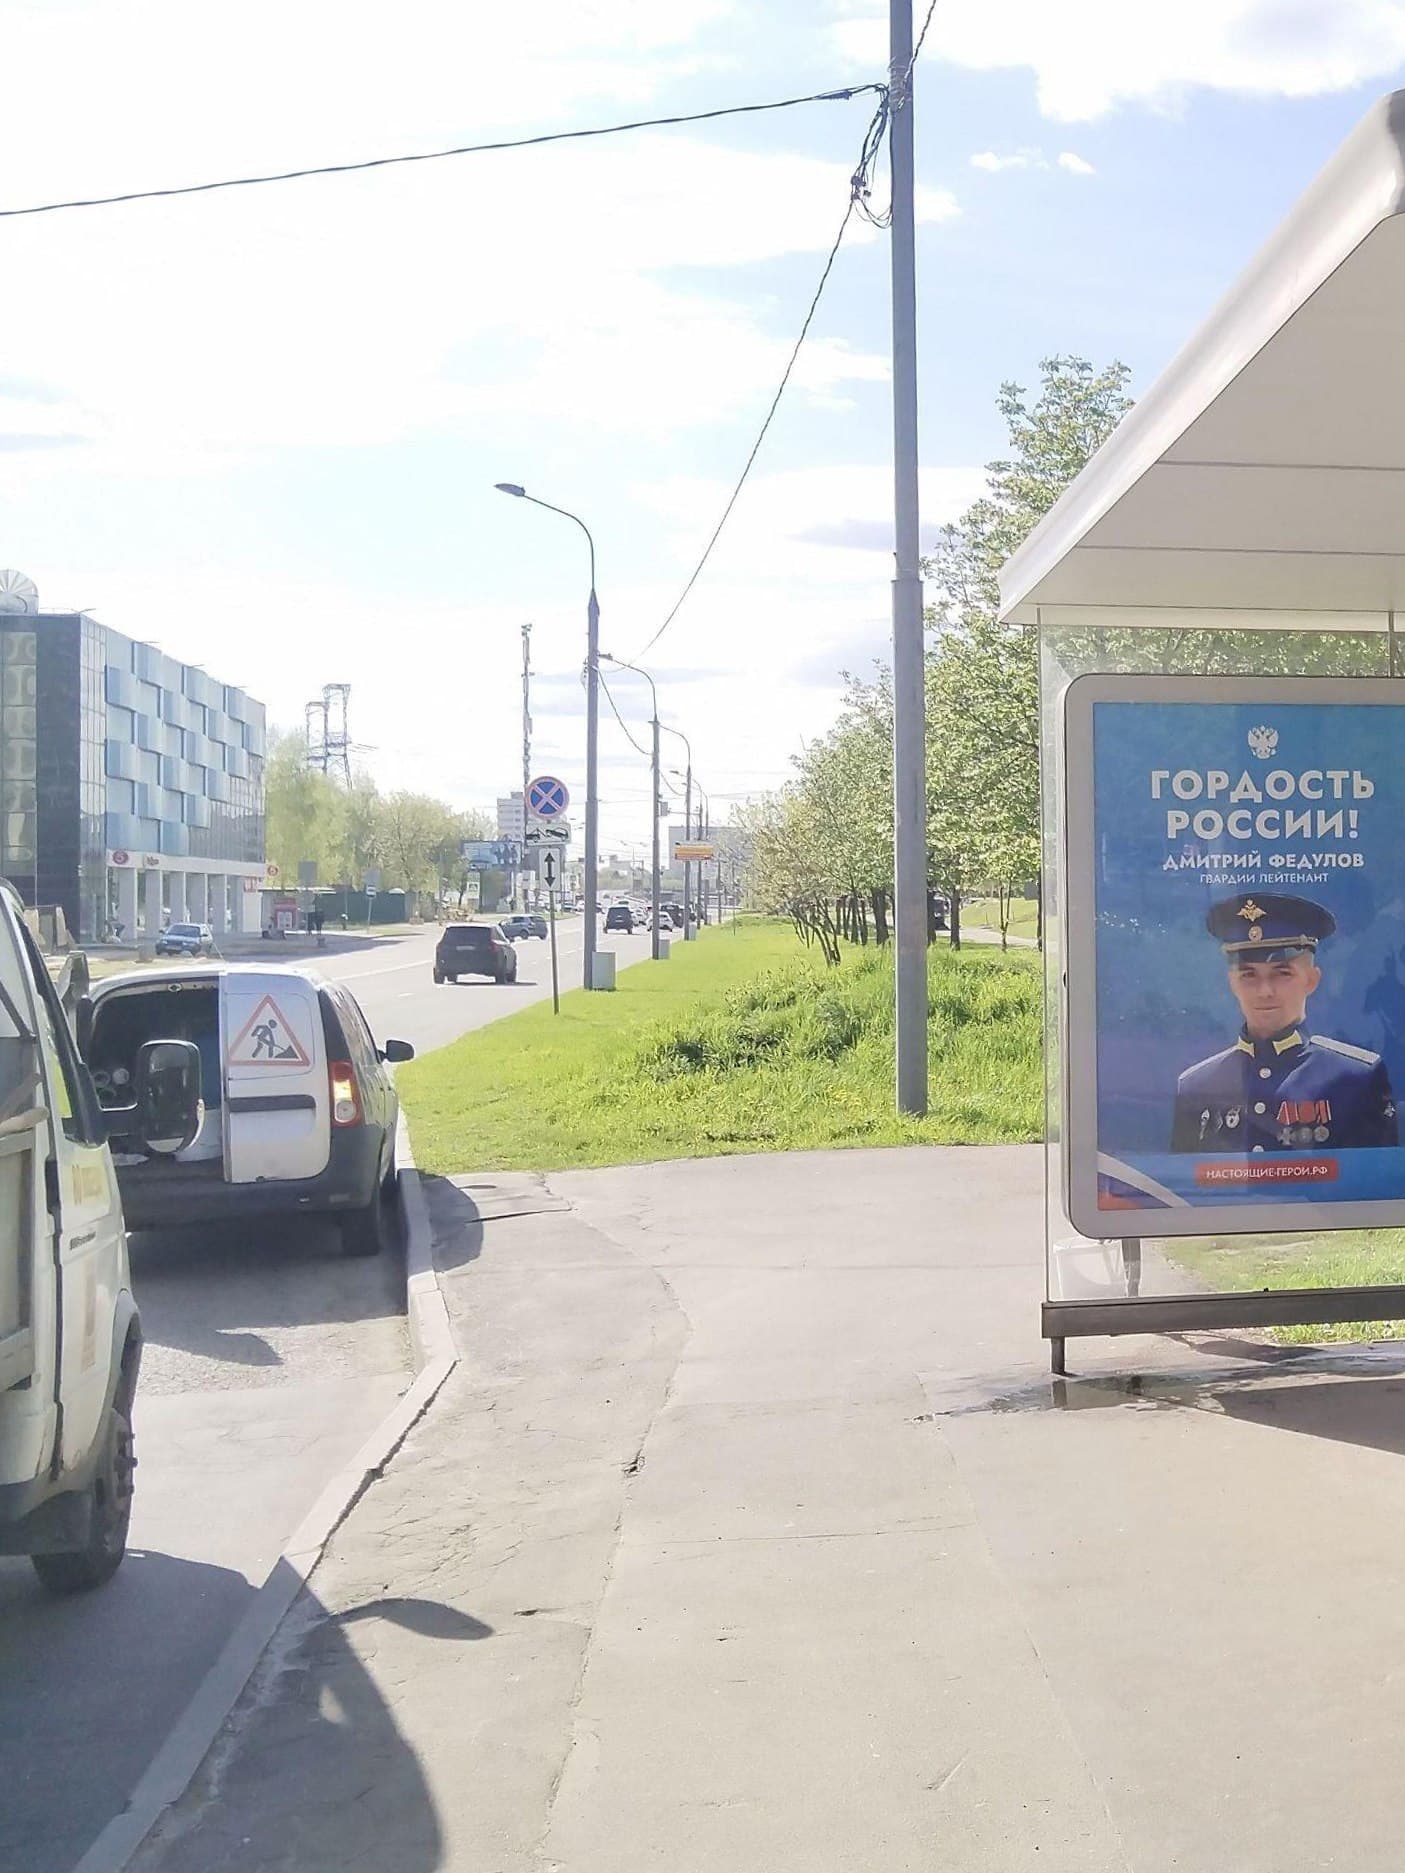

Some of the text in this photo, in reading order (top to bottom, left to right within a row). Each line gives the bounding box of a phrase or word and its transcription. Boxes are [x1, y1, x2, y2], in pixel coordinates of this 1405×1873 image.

[1150, 769, 1375, 804] ГОРДОСТЬ
[1166, 808, 1360, 840] РОССИИ!
[1162, 849, 1365, 871] ДМИТРИЙ ФЕДУЛОВ
[1200, 871, 1329, 885] ГВАРДИИ ЛЕЙТЕНАНТ
[1206, 1166, 1328, 1179] НАСТОЯЩИЕ-ГЕРОИ.РФ
